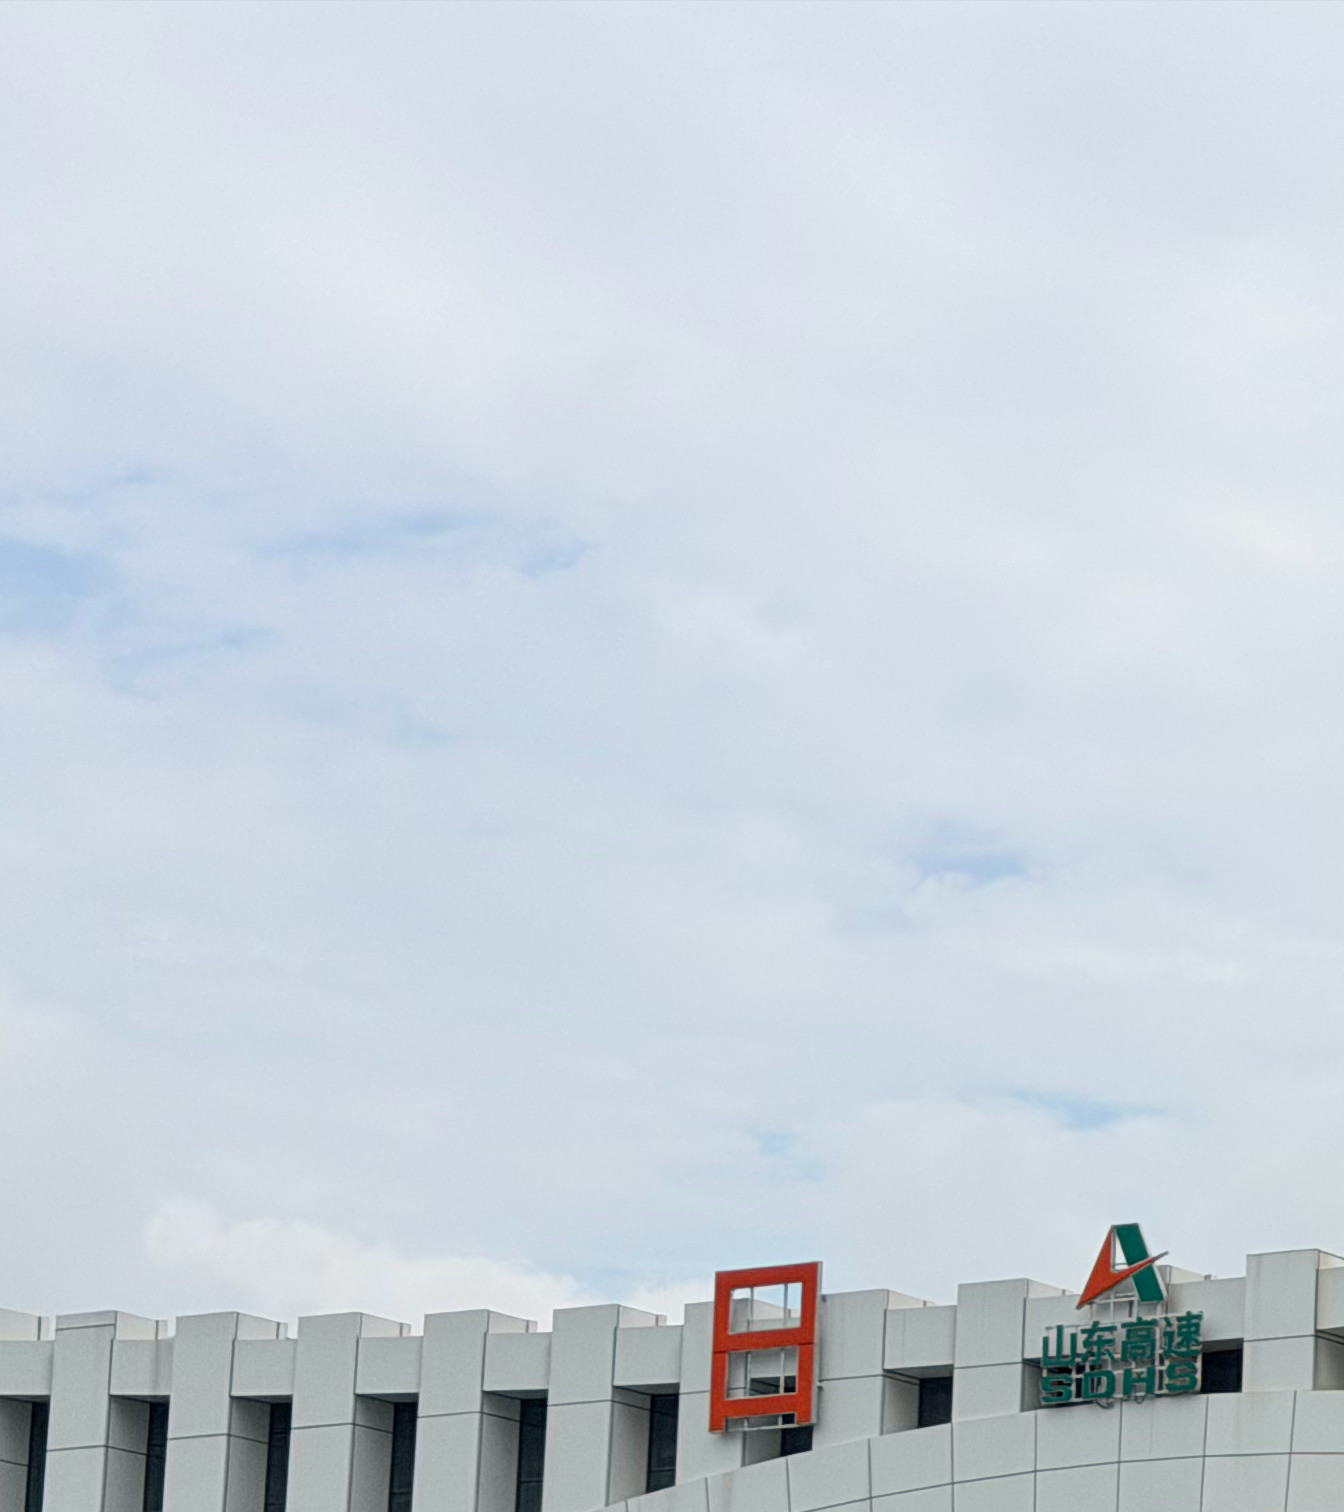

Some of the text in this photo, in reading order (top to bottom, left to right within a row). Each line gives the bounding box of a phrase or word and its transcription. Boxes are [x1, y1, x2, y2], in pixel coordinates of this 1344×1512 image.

[1041, 1310, 1204, 1368] 山东高速
[1040, 1361, 1199, 1403] SDHS
